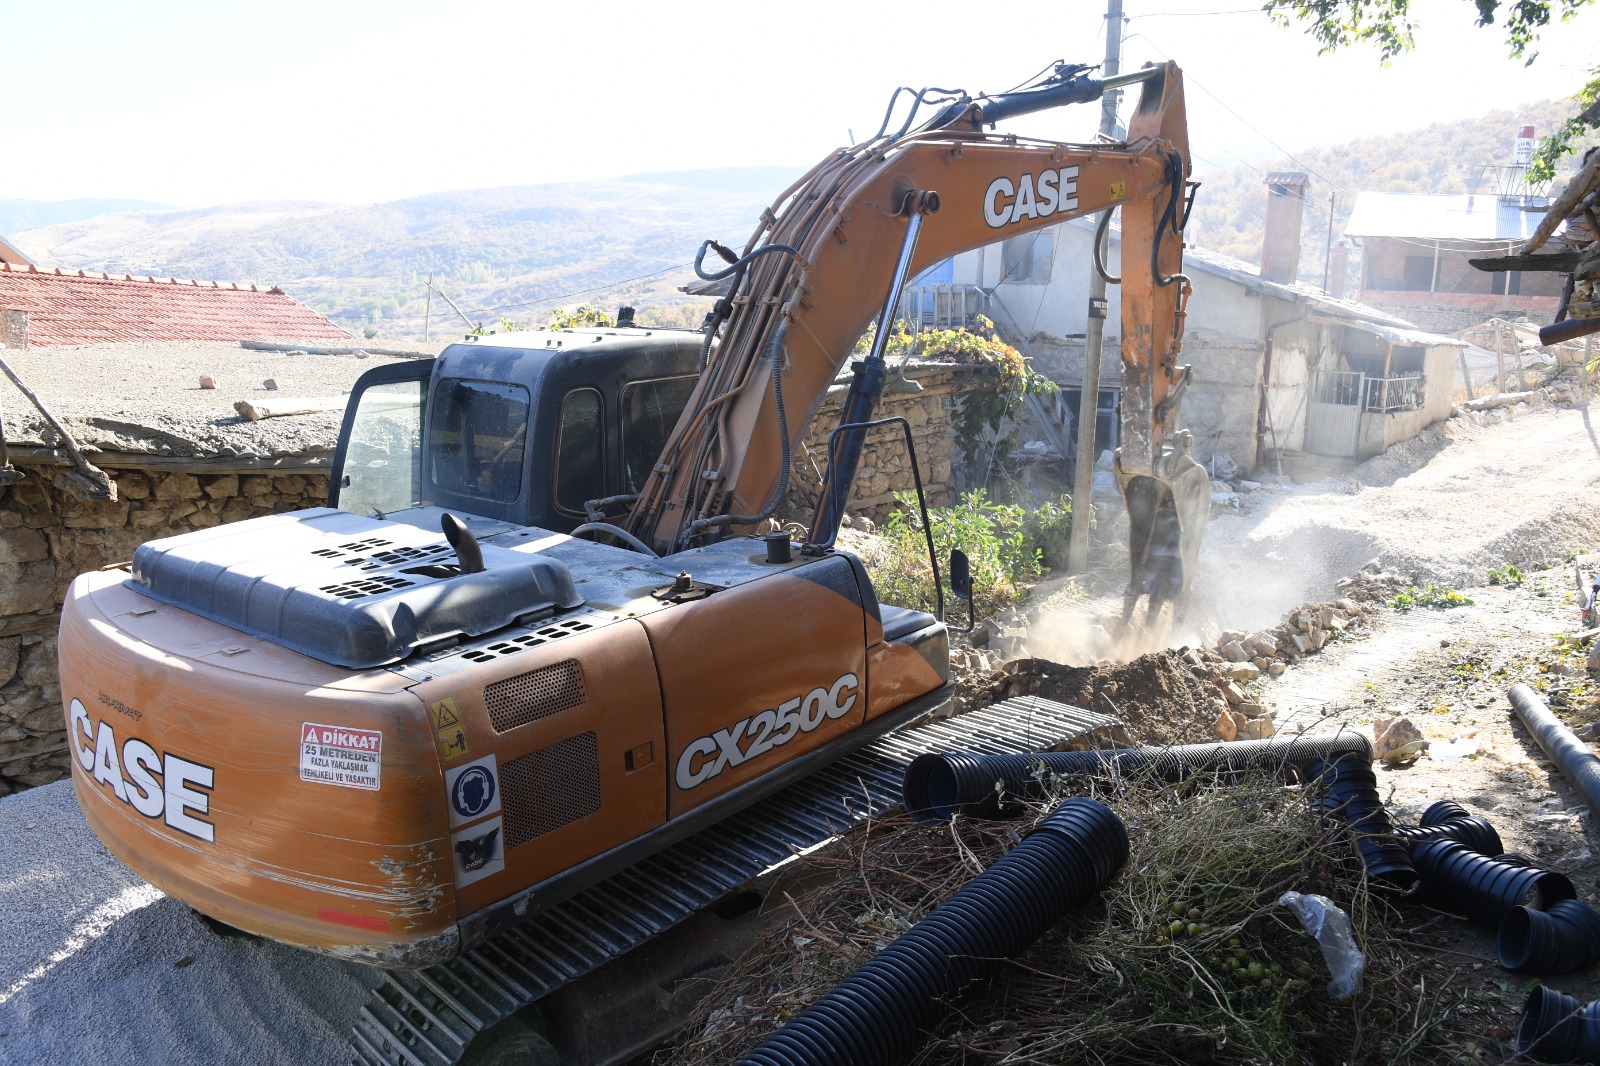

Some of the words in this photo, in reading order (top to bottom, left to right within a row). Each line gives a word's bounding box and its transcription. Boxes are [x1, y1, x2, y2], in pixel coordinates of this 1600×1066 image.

[983, 164, 1080, 229] CASE
[322, 729, 379, 750] DİKKAT
[675, 671, 859, 791] CX250C
[304, 745, 317, 756] 25
[319, 746, 377, 763] METREDEN
[69, 696, 215, 843] CASE
[310, 757, 329, 768] FAZLA
[330, 759, 369, 773] YAKLAŞMAK
[303, 767, 334, 780] TEHLİKELİ
[335, 772, 344, 782] VE
[344, 773, 376, 786] YASAKTIR
